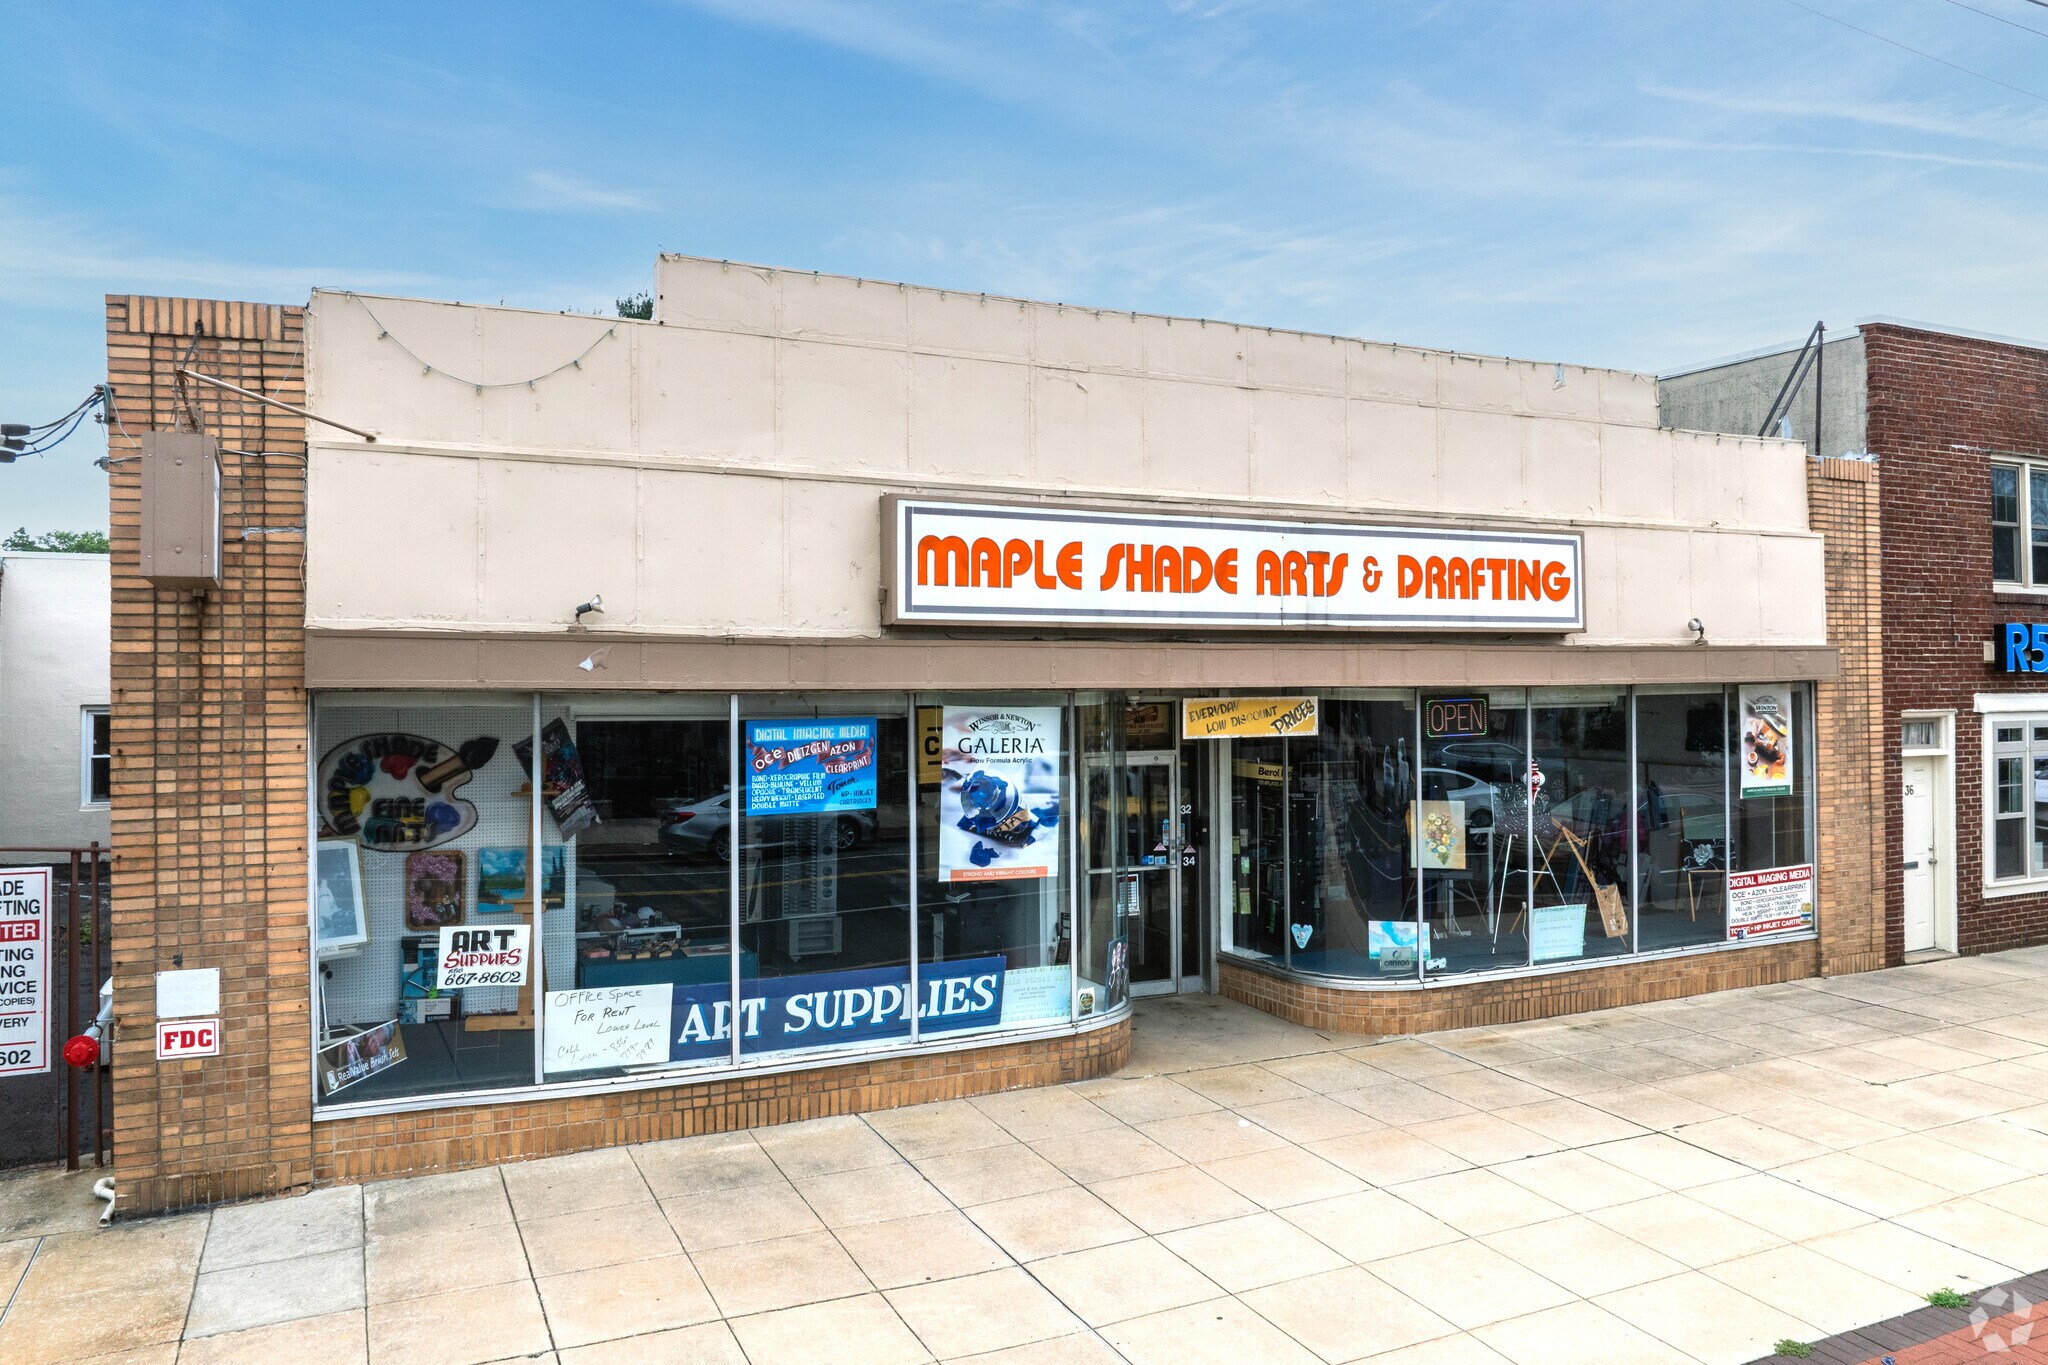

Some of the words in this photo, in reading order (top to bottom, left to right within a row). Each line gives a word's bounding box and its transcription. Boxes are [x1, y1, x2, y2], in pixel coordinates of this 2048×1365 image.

[917, 534, 1083, 592] MAPLE
[1100, 542, 1238, 595] SHADE
[1256, 550, 1348, 598] ARTS
[1362, 556, 1382, 593] &
[1398, 554, 1571, 602] DRAFTING
[1189, 700, 1239, 723] EVERYDAY
[1206, 719, 1226, 733] LOW
[1230, 705, 1278, 727] DISCOUNT
[1270, 699, 1315, 735] PRICES
[1431, 703, 1483, 732] OPEN
[969, 714, 999, 732] WINSOR
[1006, 714, 1036, 732] NEWTON
[755, 728, 788, 742] DIGITAL
[793, 727, 835, 740] IMAGING
[839, 725, 867, 738] MEDIA
[787, 740, 829, 763] DIETZGEN
[830, 742, 856, 756] AZON
[958, 737, 1044, 754] GALERIA
[826, 755, 868, 774] CLEARPRINT
[1012, 757, 1033, 765] Acrylic
[813, 772, 826, 780] FILM
[1258, 767, 1279, 777] Berol
[827, 776, 859, 795] Toner
[1905, 785, 1914, 796] 36
[752, 801, 776, 810] DOUBLE
[780, 800, 800, 808] MATTE
[839, 797, 872, 806] CARTRIDGES
[1180, 804, 1192, 815] 32
[1183, 856, 1196, 866] 34
[1730, 877, 1756, 887] DIGITAL
[1757, 872, 1788, 884] IMAGING
[1789, 869, 1810, 879] MEDIA
[1772, 883, 1807, 893] CLEARPRINT
[1763, 921, 1781, 930] INKJET
[452, 929, 516, 953] ART
[444, 948, 521, 969] SUPPLIES
[555, 991, 603, 1007] OFFICE
[783, 974, 998, 1034] SUPPLIES
[574, 1009, 595, 1025] FOR
[602, 1005, 636, 1019] RENT
[597, 1022, 630, 1035] LOWER
[634, 1019, 661, 1031] LEVEL
[163, 1028, 213, 1051] FDC
[337, 1060, 370, 1083] RealValue
[370, 1052, 388, 1069] Brush
[389, 1047, 400, 1060] Sets
